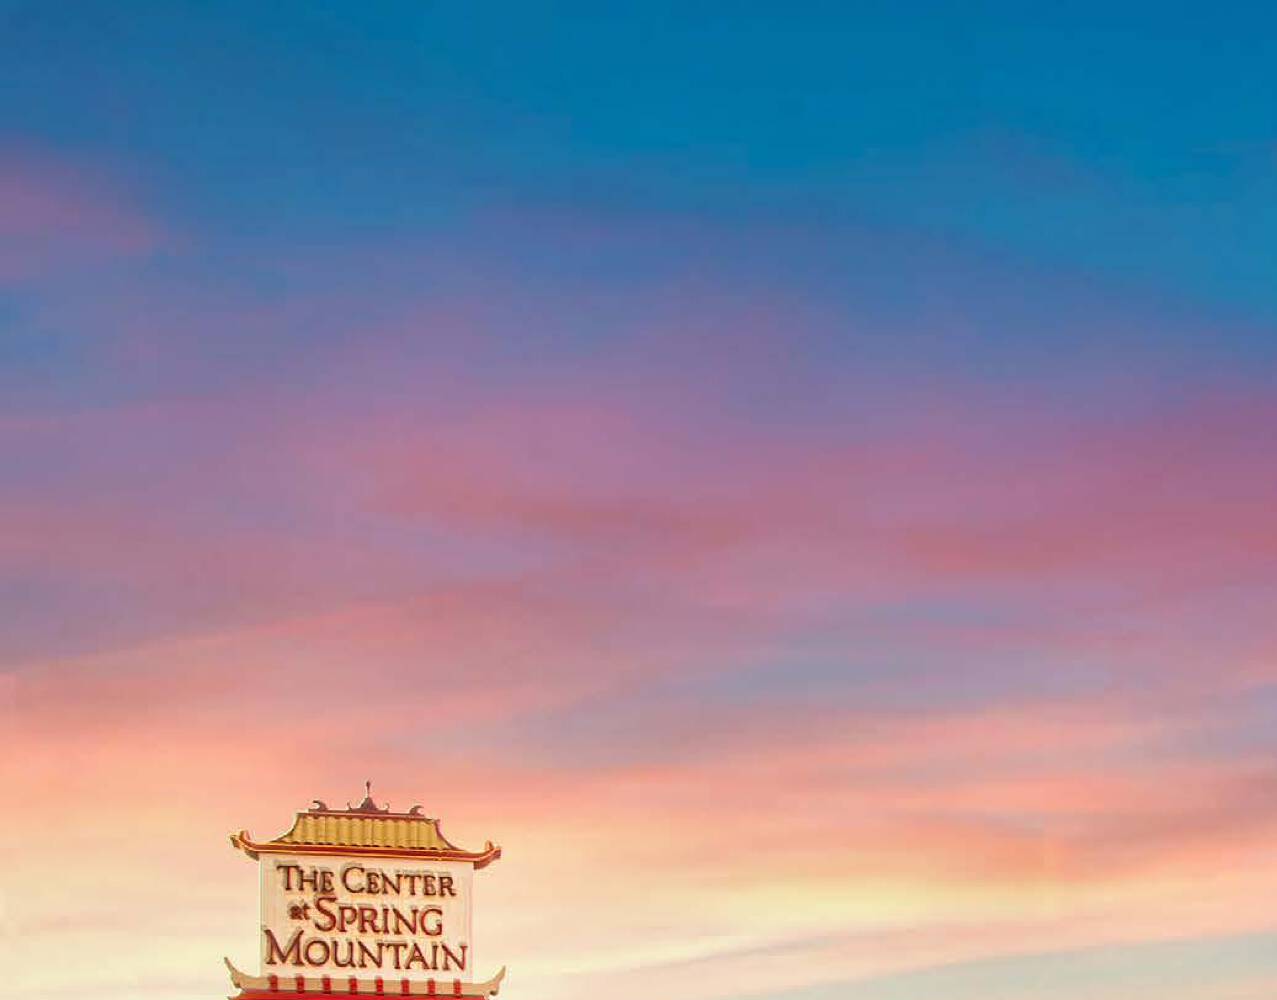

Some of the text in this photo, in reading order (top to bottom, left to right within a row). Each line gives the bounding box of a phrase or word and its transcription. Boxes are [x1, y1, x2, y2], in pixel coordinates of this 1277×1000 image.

[277, 864, 457, 897] THE CENTER
[289, 897, 443, 937] at SPRING
[264, 928, 468, 971] MOUNTAIN
